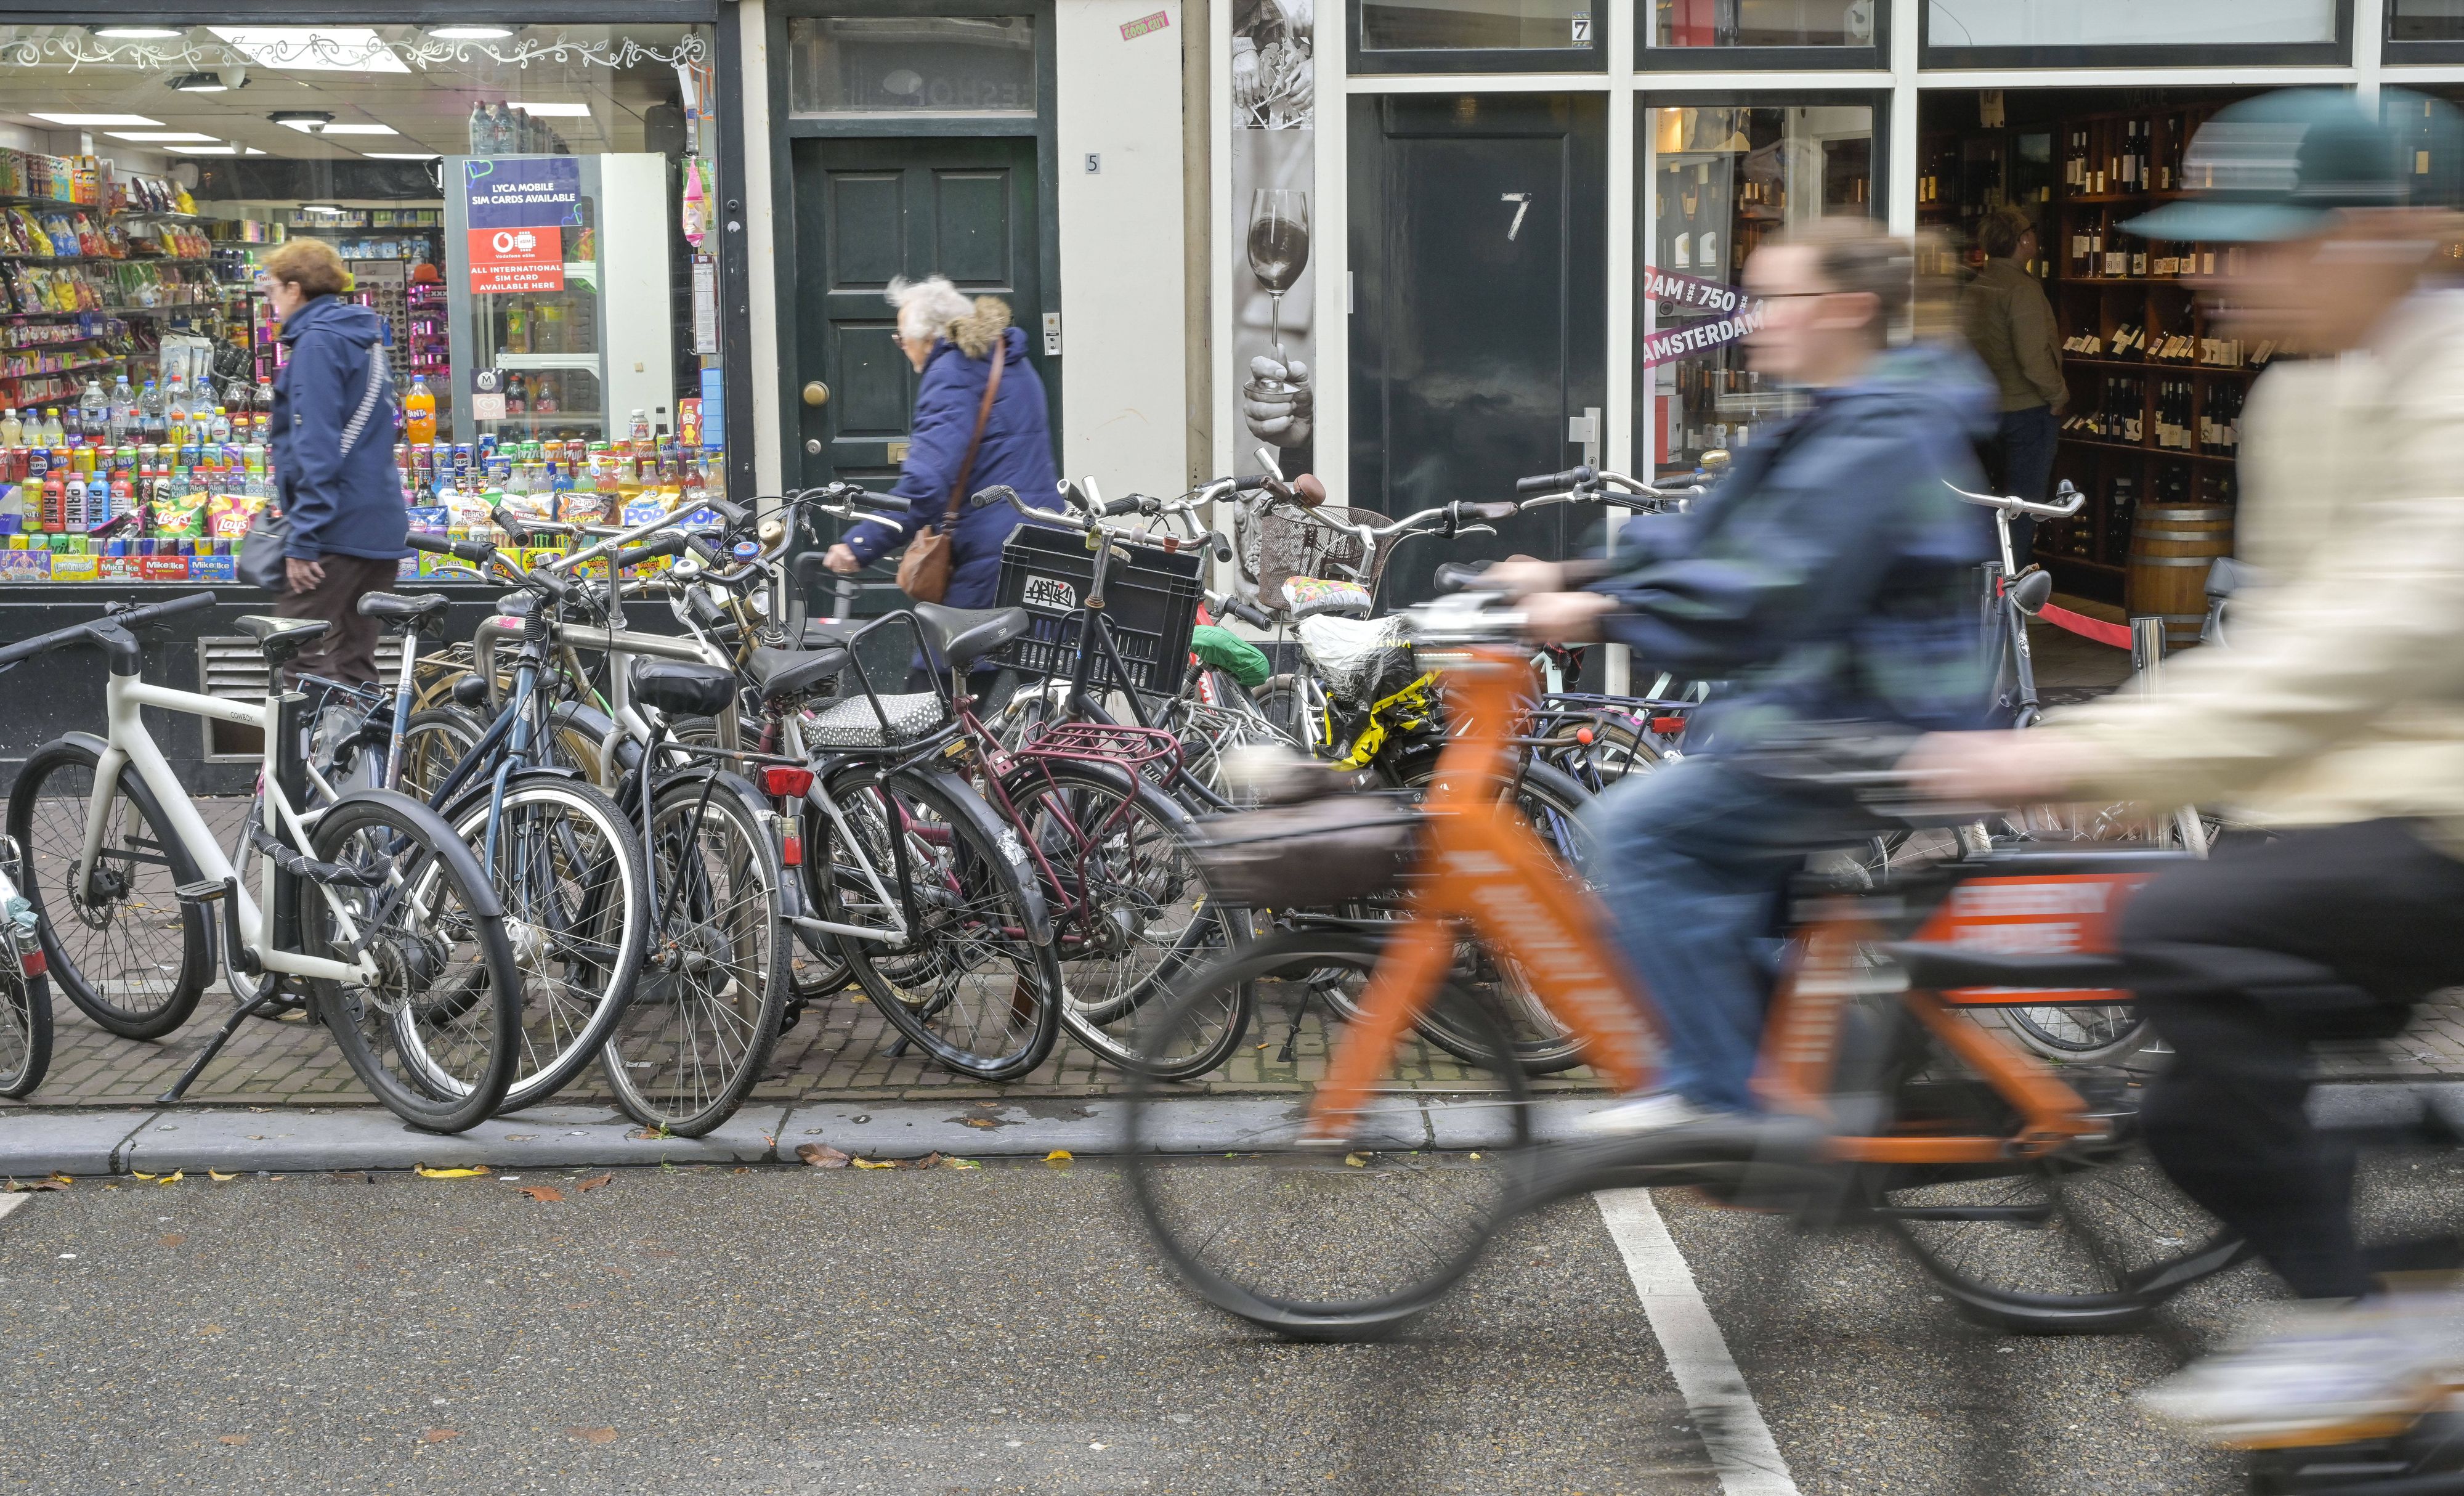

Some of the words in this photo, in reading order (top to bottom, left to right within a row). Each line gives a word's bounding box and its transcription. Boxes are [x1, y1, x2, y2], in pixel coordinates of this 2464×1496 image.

[1124, 23, 1148, 39] GOOD
[1148, 16, 1166, 31] GUY
[1574, 21, 1589, 39] 7
[1088, 155, 1098, 171] 5
[492, 184, 516, 193] LYCA
[518, 183, 554, 192] MOBILE
[472, 196, 490, 205] SIM
[491, 195, 524, 204] CARDS
[525, 193, 575, 203] AVAILABLE
[1501, 192, 1531, 242] 7
[490, 265, 561, 273] INTERNATIONAL
[479, 283, 529, 291] AVAILABLE
[1698, 285, 1736, 312] 750
[1643, 310, 1765, 363] AMSTERDAM
[482, 376, 492, 384] M
[407, 409, 427, 418] FANTA
[171, 483, 186, 491] Aloe
[190, 483, 205, 491] Aloe
[43, 490, 57, 523] PRIME
[67, 489, 81, 523] PRIME
[89, 490, 103, 523] PRIME
